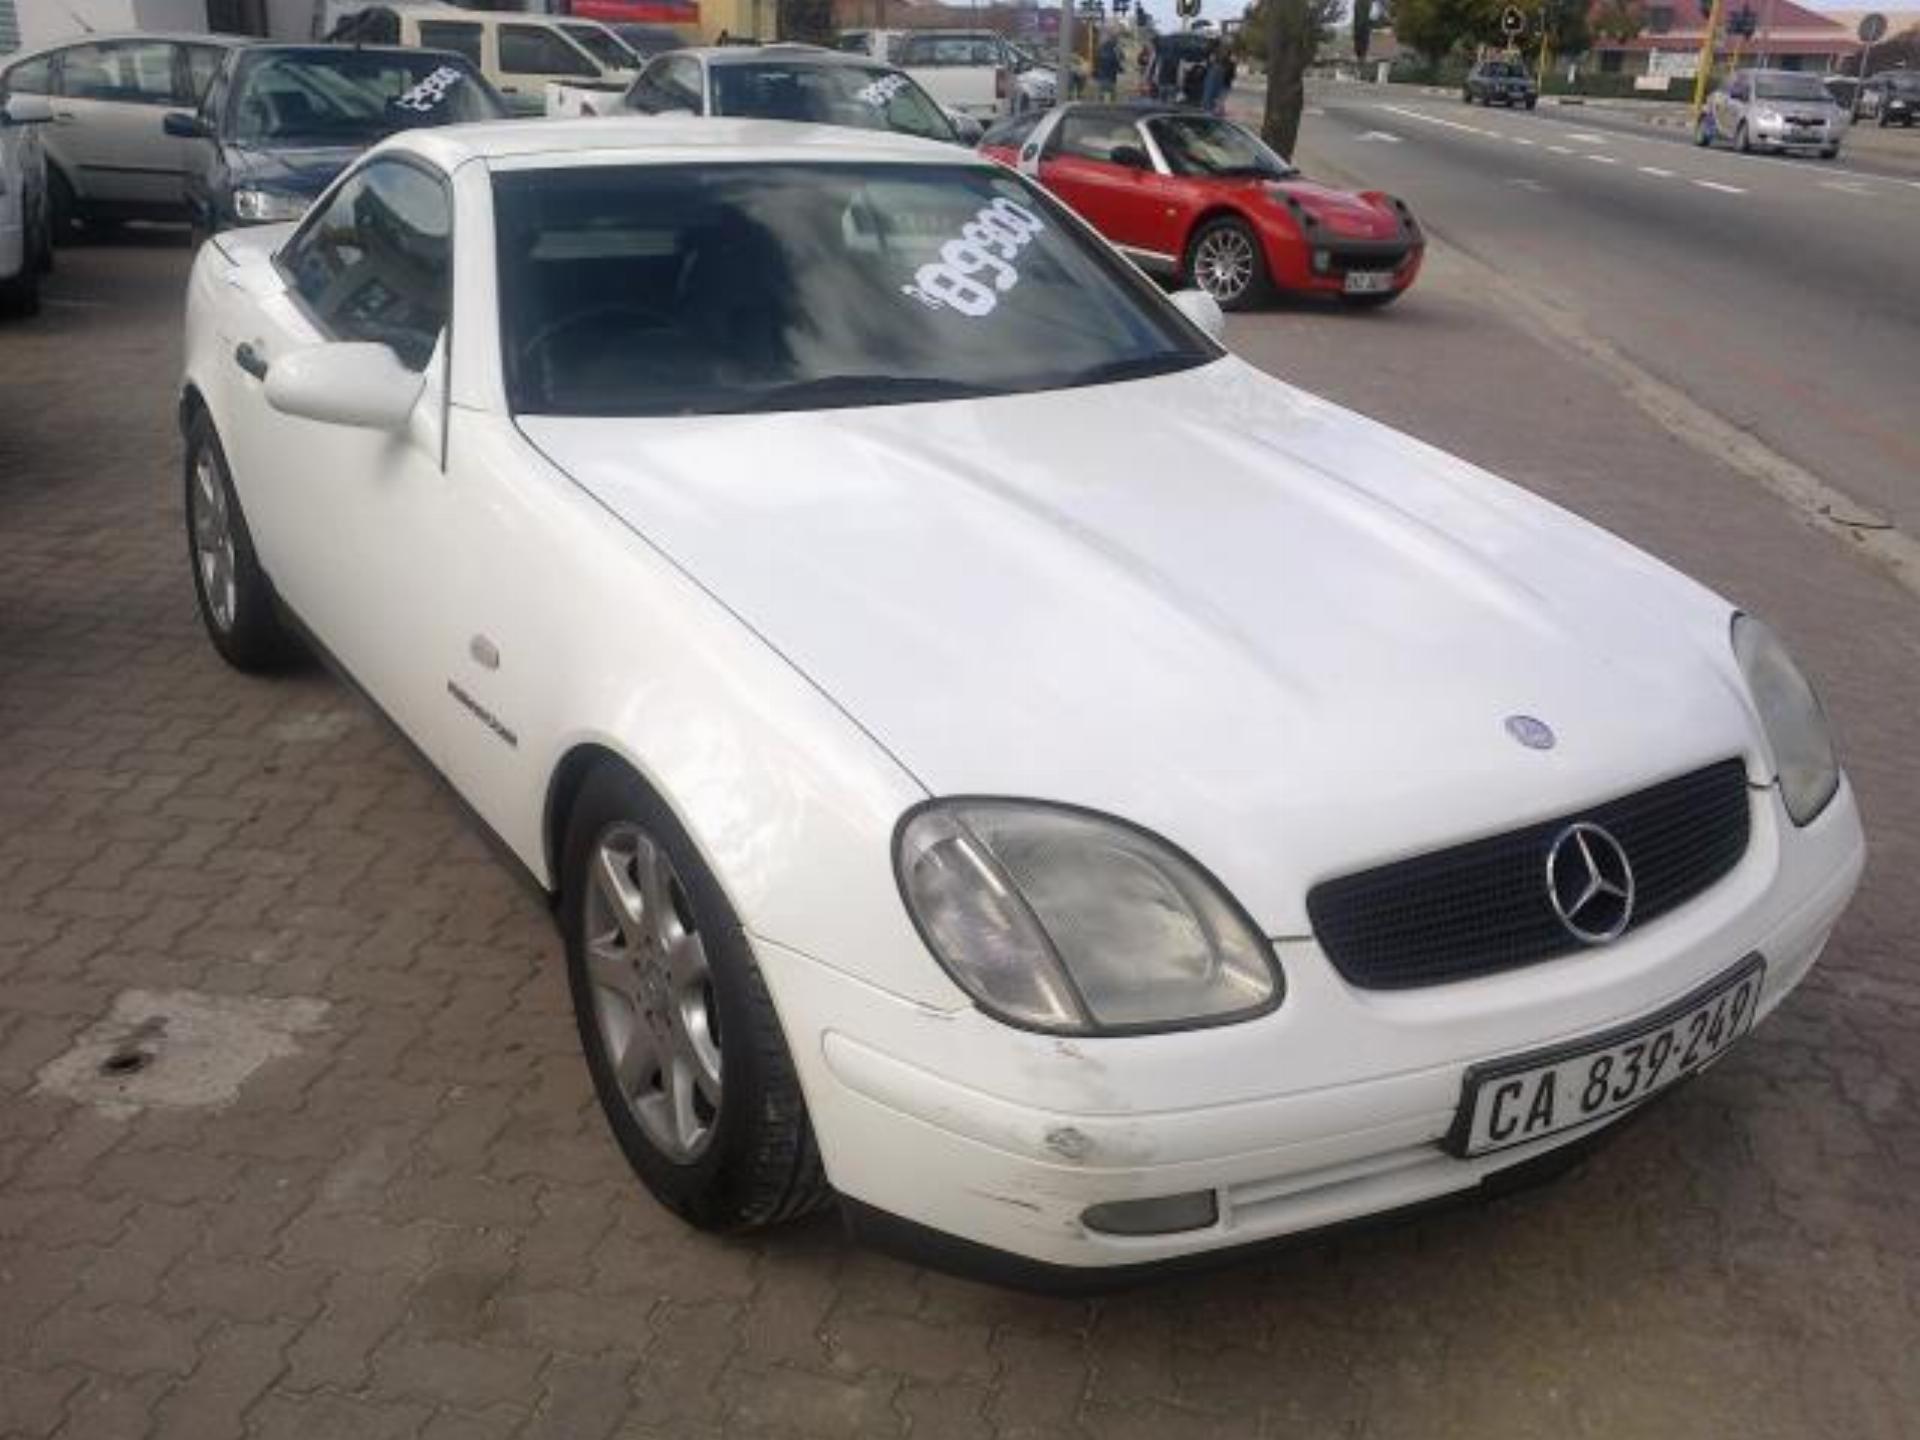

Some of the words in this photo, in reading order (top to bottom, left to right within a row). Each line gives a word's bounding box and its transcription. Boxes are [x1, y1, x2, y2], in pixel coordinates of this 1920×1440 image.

[914, 197, 1045, 316] 89900
[1488, 1070, 1557, 1141] CA
[1580, 981, 1751, 1113] 839-249
